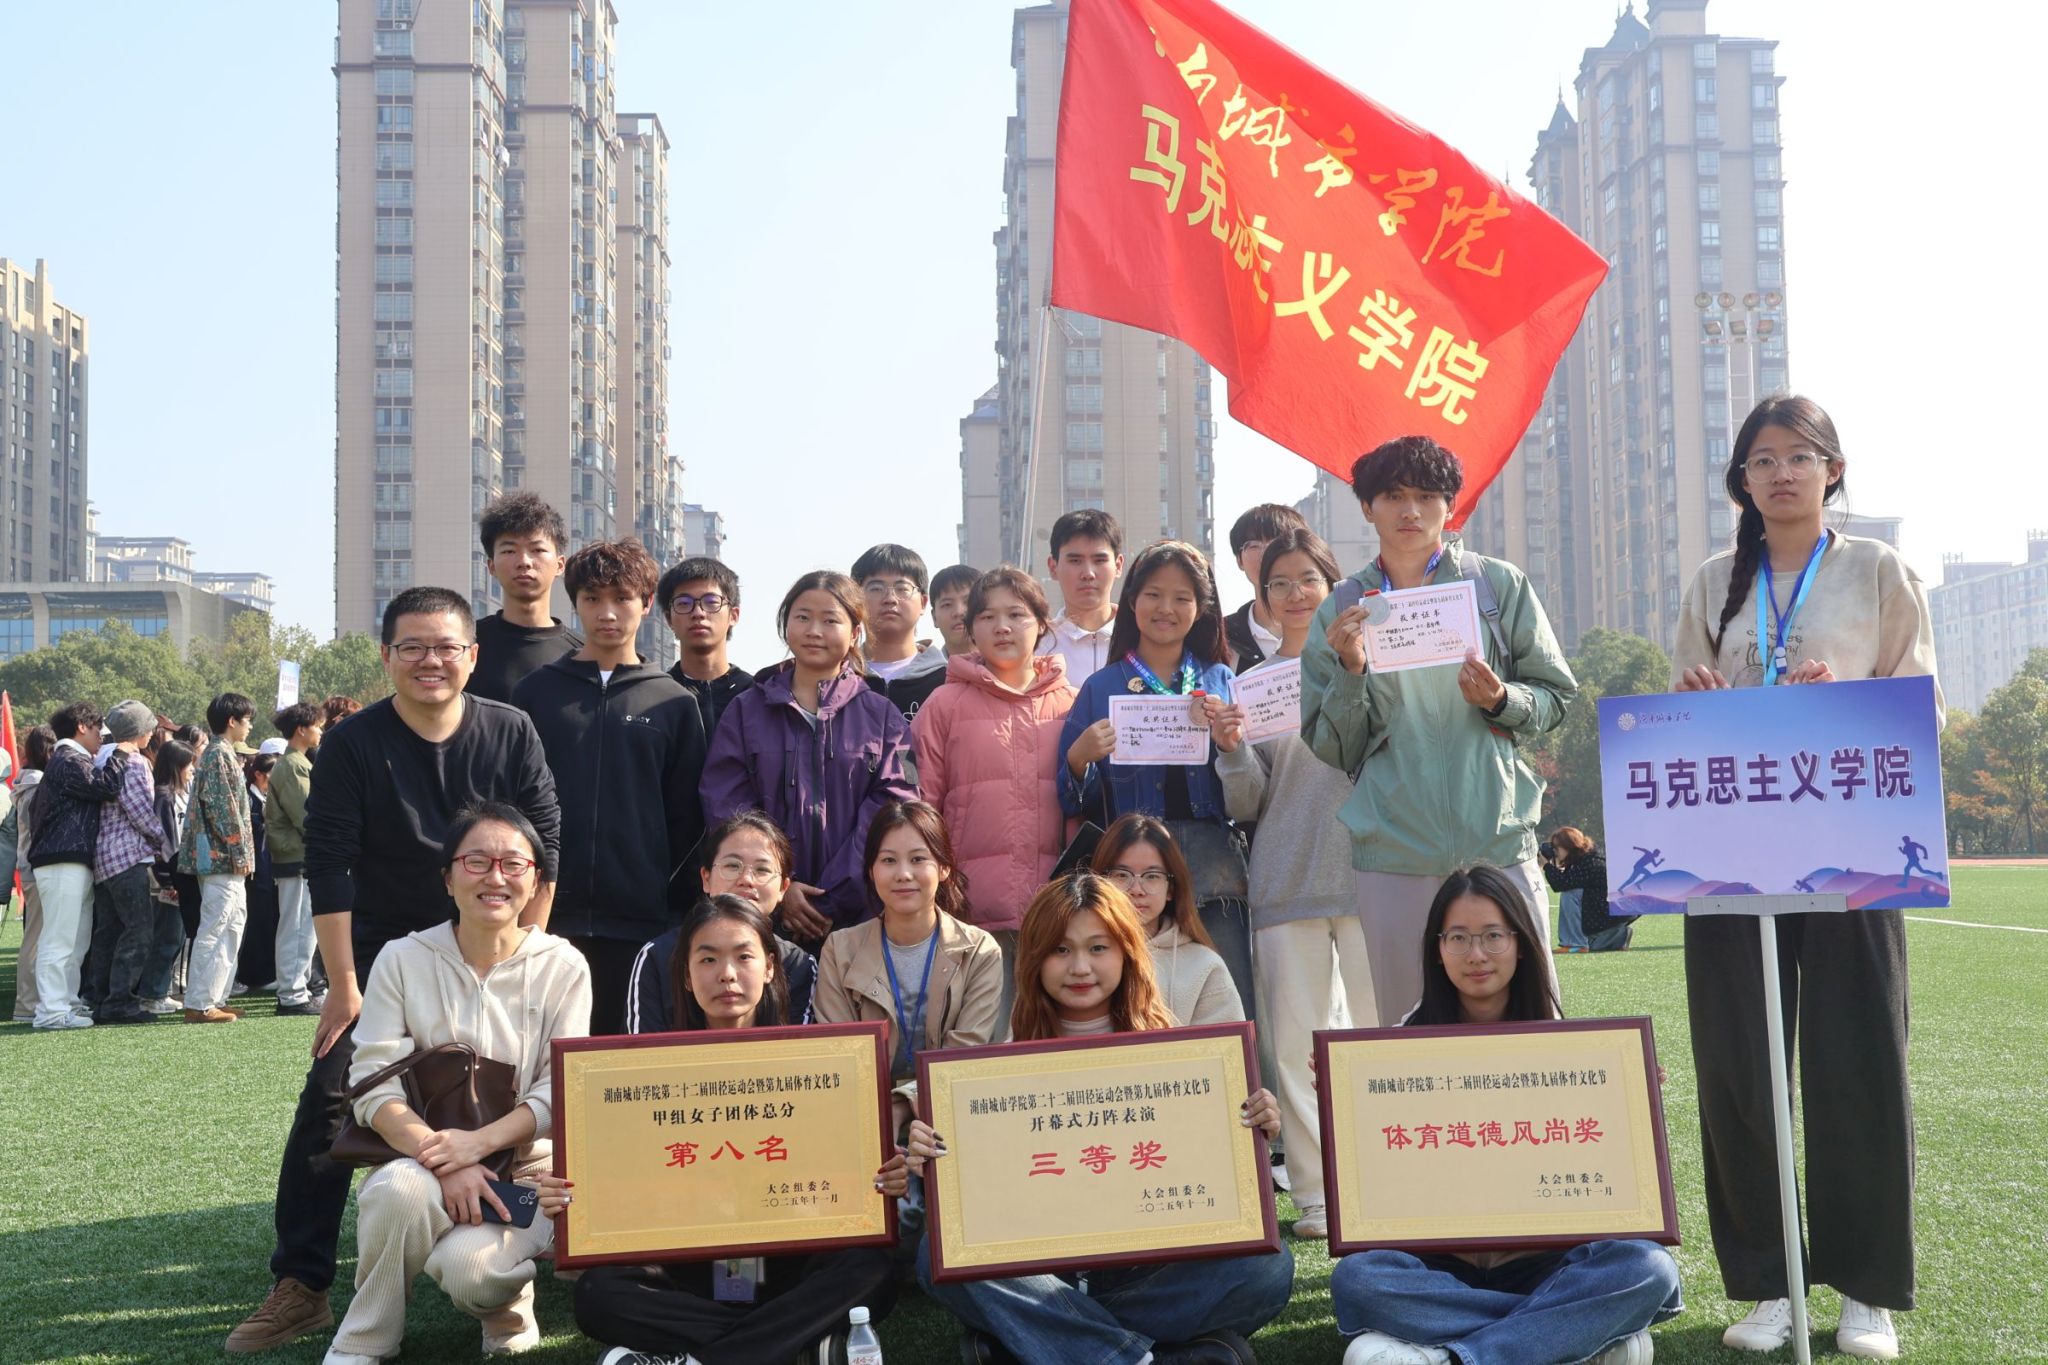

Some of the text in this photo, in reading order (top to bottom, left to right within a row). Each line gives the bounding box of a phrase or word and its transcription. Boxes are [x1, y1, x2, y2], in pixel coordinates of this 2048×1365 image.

[1626, 746, 1916, 810] 马克思主义学院
[603, 1072, 841, 1104] 湖南城市学院第二十二届田径运动会暨第九届体育文化节
[969, 1078, 1211, 1115] 湖南城市学院第二十二届田径运动会暨第九届体育文化节
[1368, 1069, 1607, 1095] 湖南城市学院第二十二届田径运动会暨第九届体育文化节
[653, 1101, 796, 1127] 甲组女子团体总分
[1030, 1105, 1156, 1132] 开幕式方阵表演
[1382, 1117, 1604, 1150] 体育道德风尚奖
[664, 1135, 789, 1168] 第八名
[1028, 1141, 1168, 1177] 三等奖
[767, 1180, 830, 1194] 大会组委会
[1143, 1184, 1206, 1199] 大会组委会
[1538, 1172, 1603, 1185] 大会组委会
